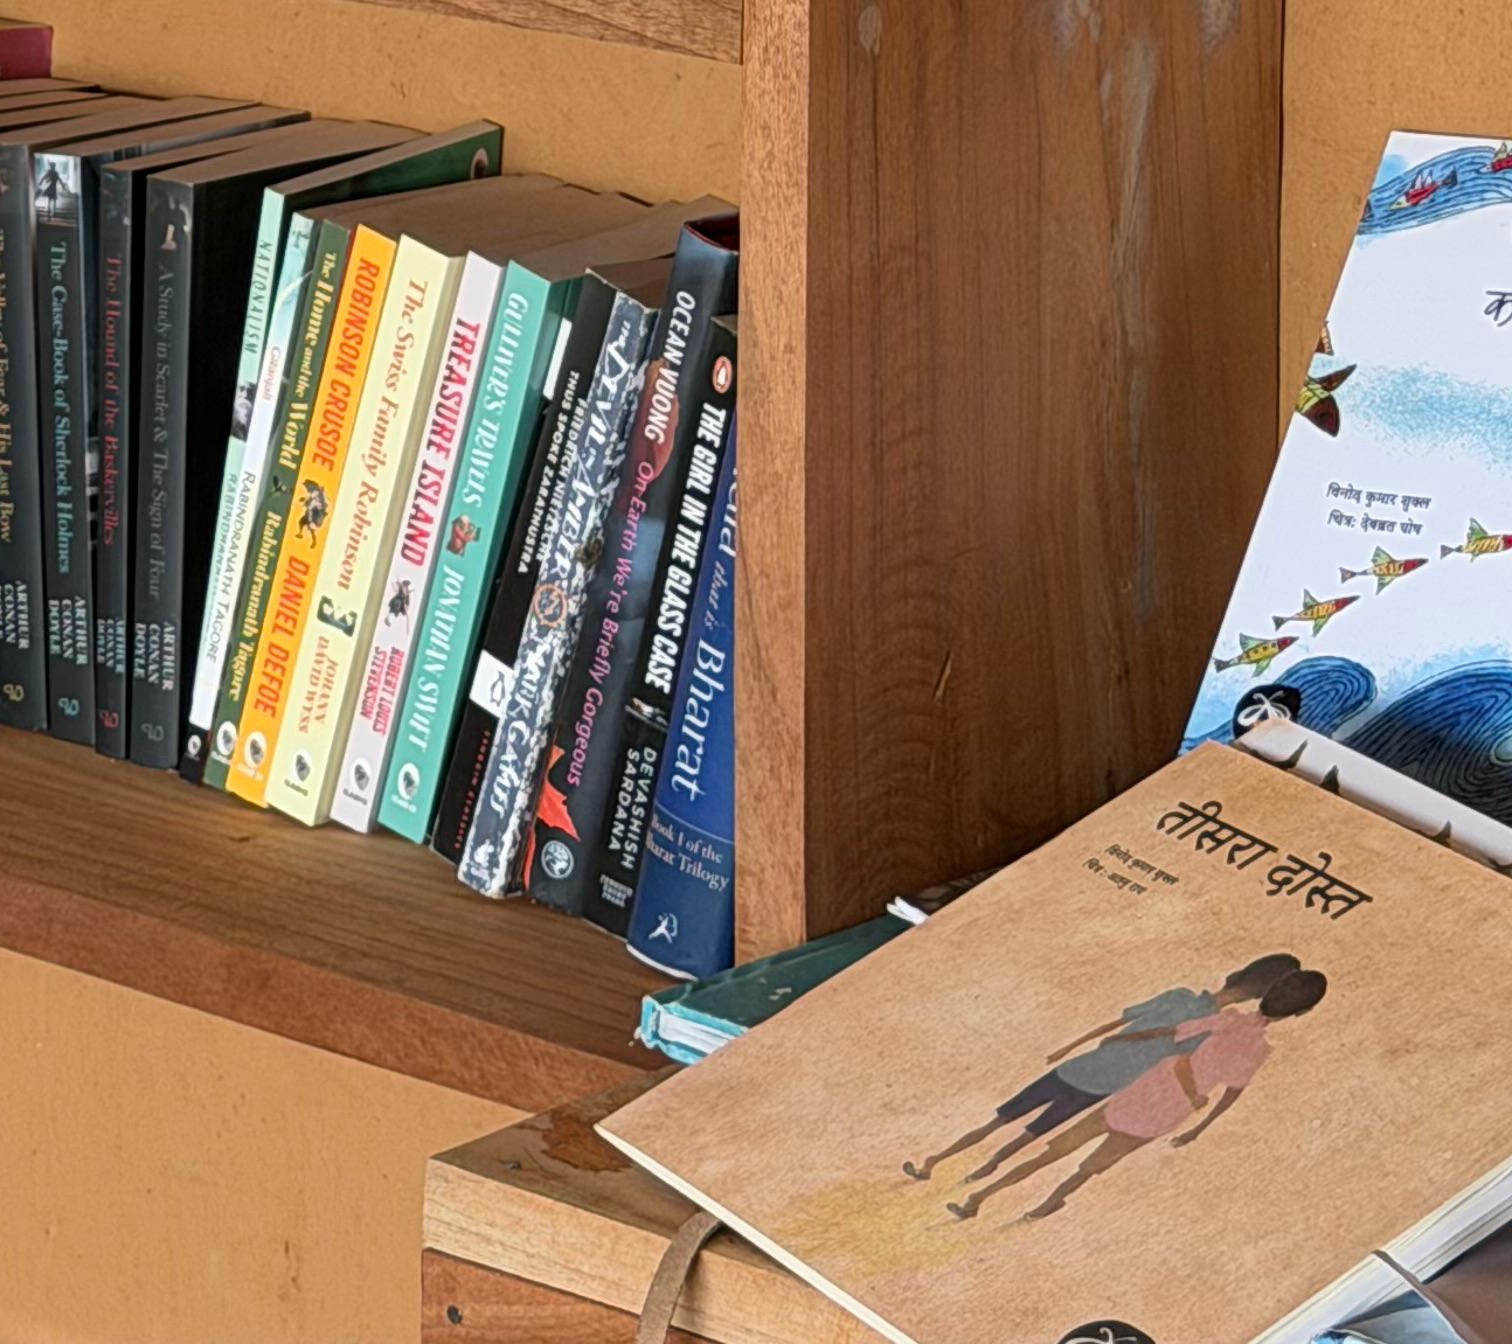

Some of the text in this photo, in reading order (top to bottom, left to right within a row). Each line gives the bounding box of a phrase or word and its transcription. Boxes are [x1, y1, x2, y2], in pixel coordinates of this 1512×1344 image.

[312, 258, 380, 472] ROBINSON CRUSOE
[337, 279, 428, 592] The Swiss Family Robinson
[399, 317, 481, 567] TREASURE ISLAND
[643, 291, 696, 445] OCEAN VUONG
[463, 418, 501, 508] TRAVELS
[643, 402, 726, 695] THE GIRL IN THE GLASS CASE
[253, 555, 310, 719] DANIEL DEFOE
[407, 566, 465, 753] JONATHAN SWIFT
[606, 747, 640, 853] SARDANA
[670, 638, 726, 802] Bharat
[620, 746, 659, 870] DEVASHISH
[1156, 800, 1373, 920] तीसरा दोस्त
